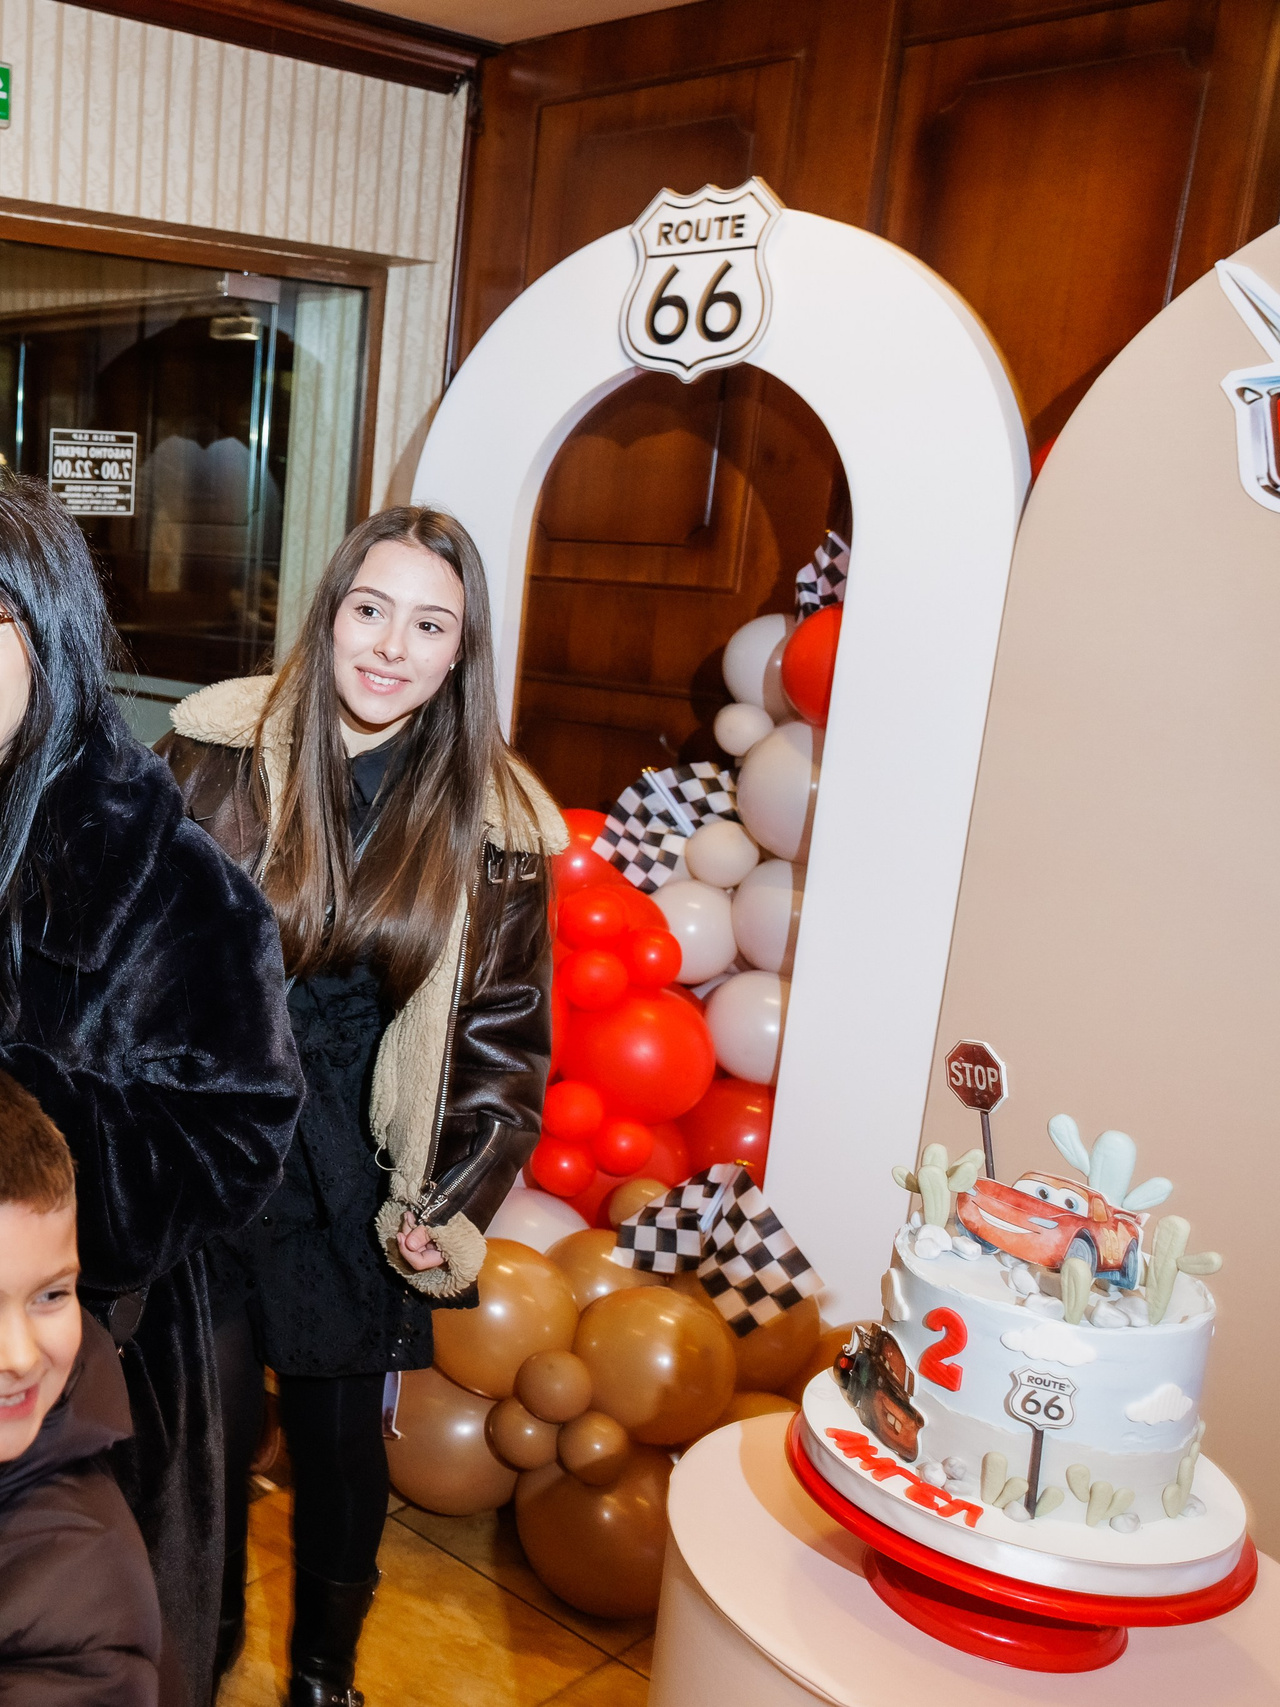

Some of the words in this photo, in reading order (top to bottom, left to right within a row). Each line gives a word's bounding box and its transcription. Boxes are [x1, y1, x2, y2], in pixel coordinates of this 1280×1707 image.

[656, 213, 746, 247] ROUTE
[645, 260, 742, 345] 66
[950, 1060, 998, 1092] STOP
[918, 1306, 968, 1392] 2
[1021, 1389, 1065, 1421] 66
